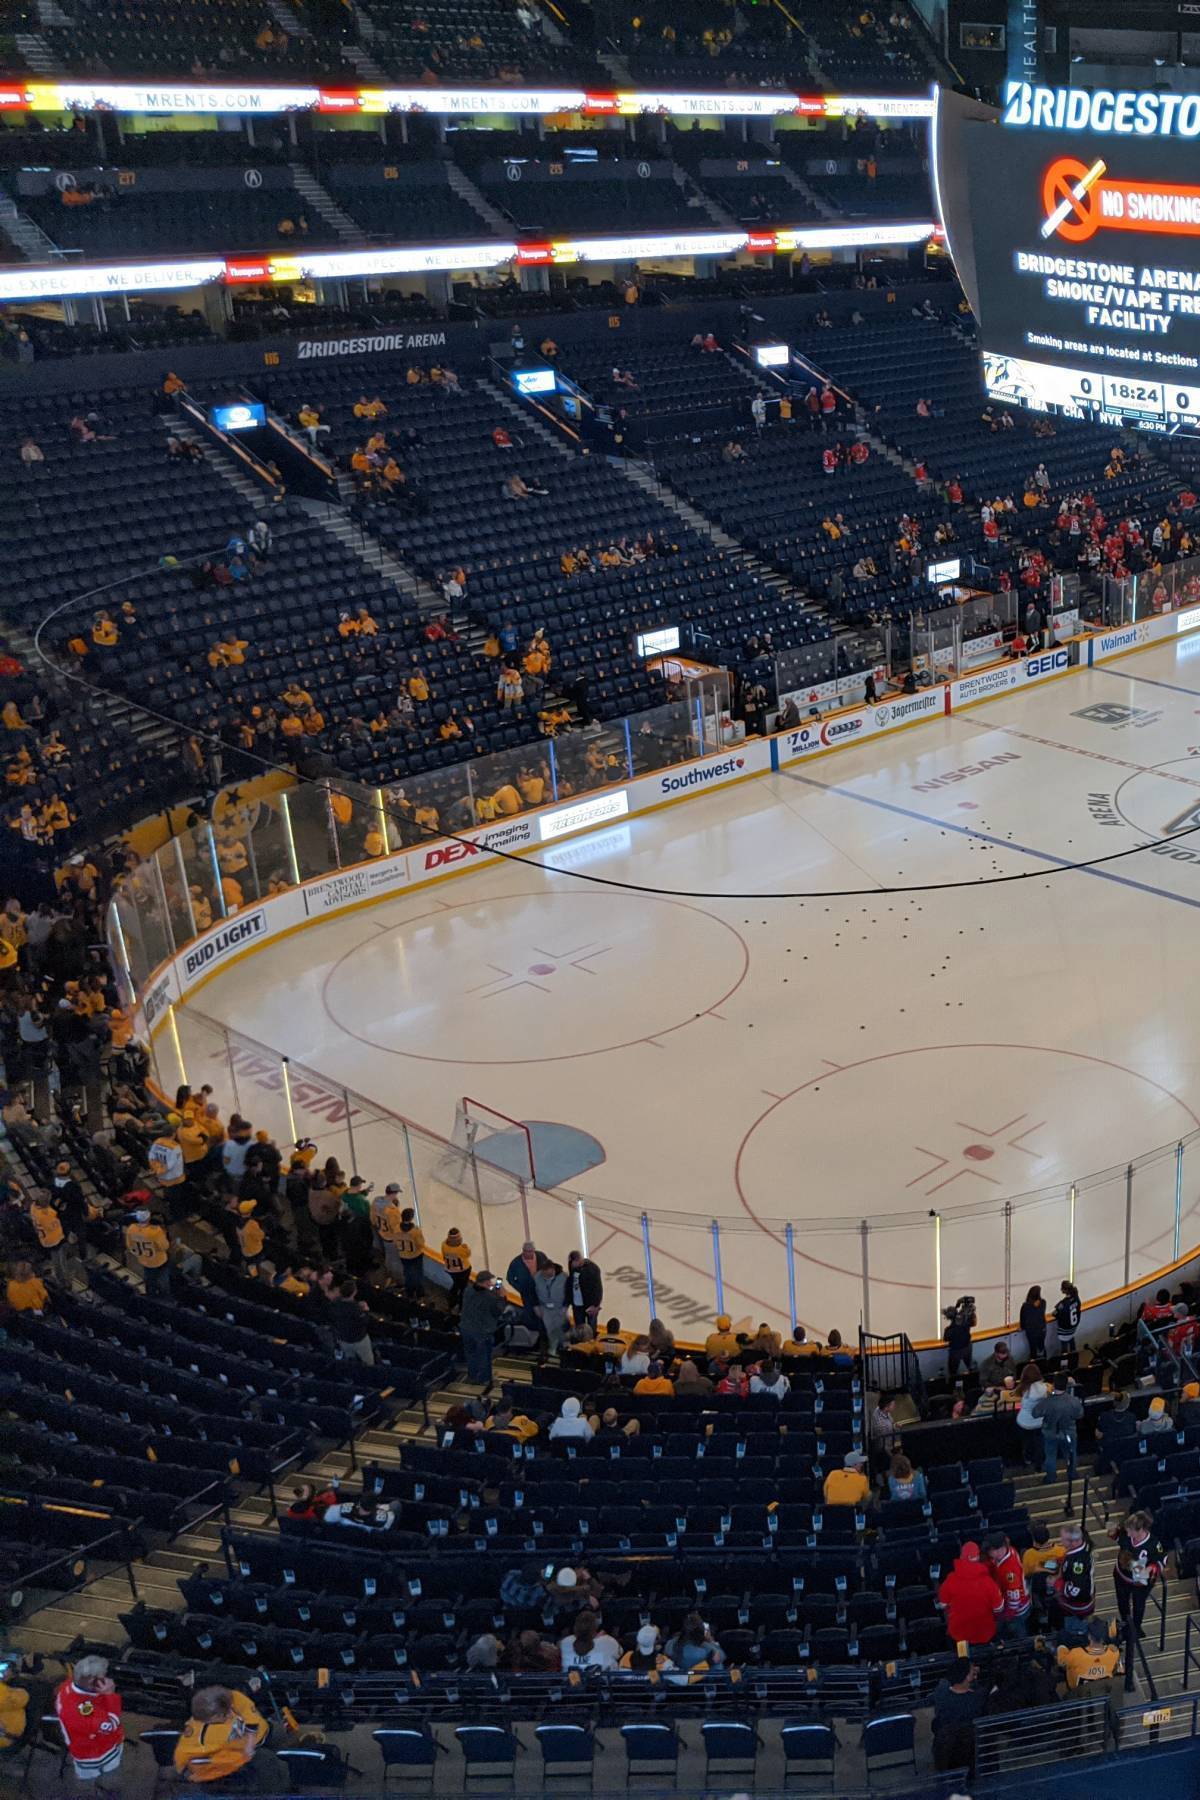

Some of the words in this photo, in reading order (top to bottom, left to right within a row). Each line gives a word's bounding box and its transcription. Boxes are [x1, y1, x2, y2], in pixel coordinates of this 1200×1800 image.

[135, 92, 262, 108] TMRENTS.COM
[440, 95, 540, 110] TMRENTS.COM
[1101, 190, 1124, 218] NO
[1017, 252, 1136, 286] BRIDGESTONE
[106, 274, 128, 286] WE
[1046, 278, 1163, 311] SMOKE/VAPE
[1088, 306, 1171, 334] FACILITY
[297, 334, 403, 359] BRIDGESTONE
[407, 332, 446, 348] ARENA
[1027, 332, 1063, 351] Smoking
[1064, 338, 1088, 353] areas
[1090, 343, 1105, 354] are
[1106, 344, 1140, 361] located
[1142, 349, 1153, 361] at
[1154, 350, 1198, 367] Sections
[1080, 377, 1092, 395] 0
[1109, 382, 1159, 403] 18:24
[1176, 392, 1190, 410] 0
[1062, 404, 1085, 420] CHA
[1100, 412, 1123, 427] NYK
[1155, 422, 1167, 432] PM
[1101, 628, 1138, 652] Walmart
[959, 670, 1008, 691] BRENTWOOD
[959, 686, 977, 699] AUTO
[977, 678, 1009, 696] BROKERS
[787, 729, 810, 746] $70
[791, 740, 820, 754] MILLION
[661, 757, 736, 793] Southwest
[909, 751, 1023, 794] NISSAN
[1087, 792, 1127, 827] ARENA
[485, 821, 529, 842] imaging
[490, 830, 531, 851] mailing
[424, 836, 481, 870] DEX
[308, 871, 365, 897] BRENTWOOD
[370, 867, 391, 880] Mergers
[322, 887, 367, 908] ADVISORS
[328, 879, 365, 899] CAPITAL
[186, 942, 214, 975] BUD
[216, 914, 263, 952] LIGHT
[209, 1045, 362, 1124] NISSAN
[573, 1655, 592, 1665] KANE
[1088, 1666, 1105, 1676] JOSI
